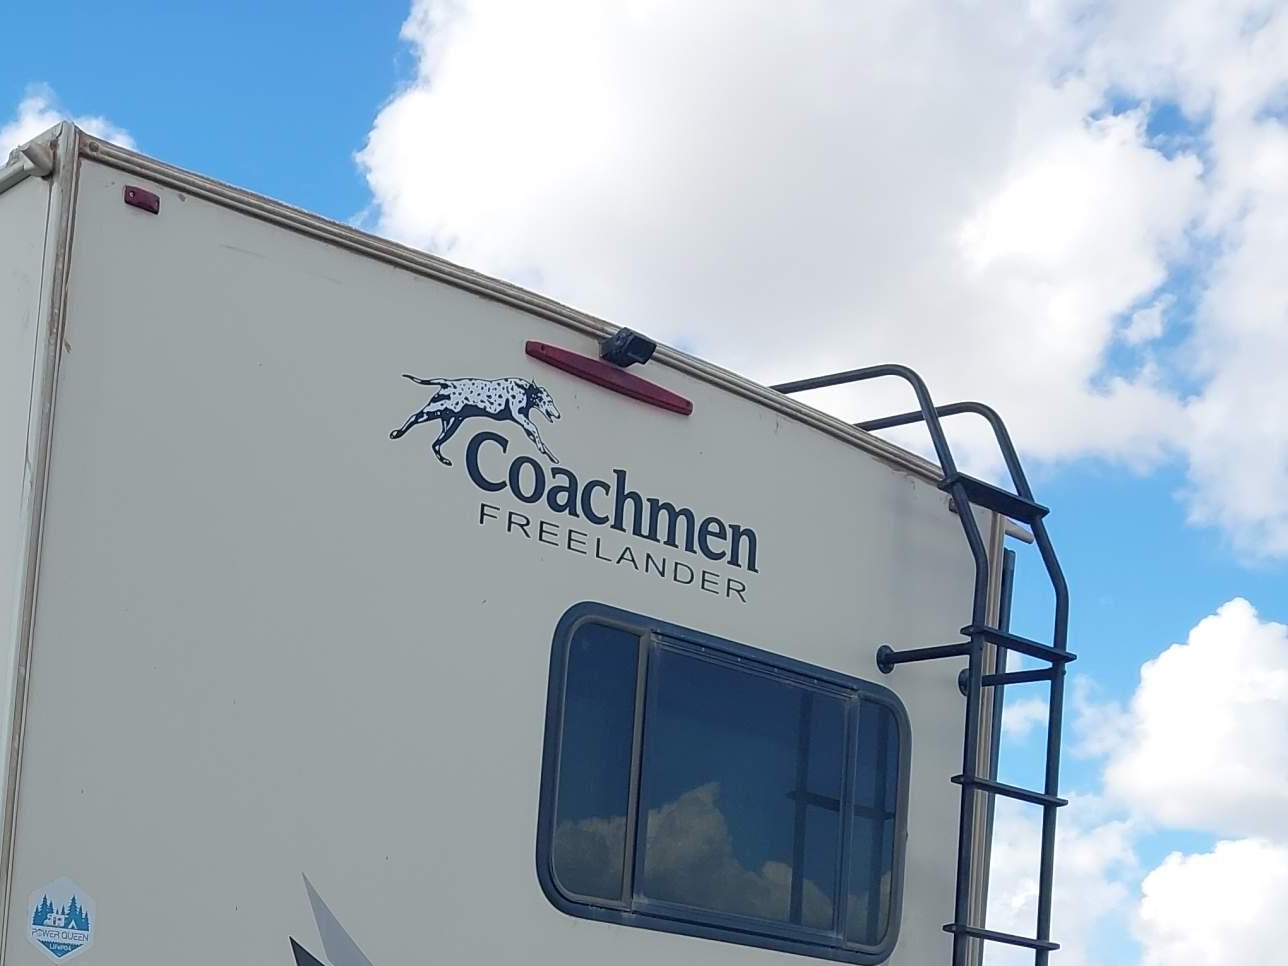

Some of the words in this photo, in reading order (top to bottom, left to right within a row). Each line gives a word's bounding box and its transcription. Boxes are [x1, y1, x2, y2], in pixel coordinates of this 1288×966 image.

[465, 431, 760, 574] Coachmen
[478, 502, 748, 603] FREELANDER
[61, 931, 89, 941] QUEEN
